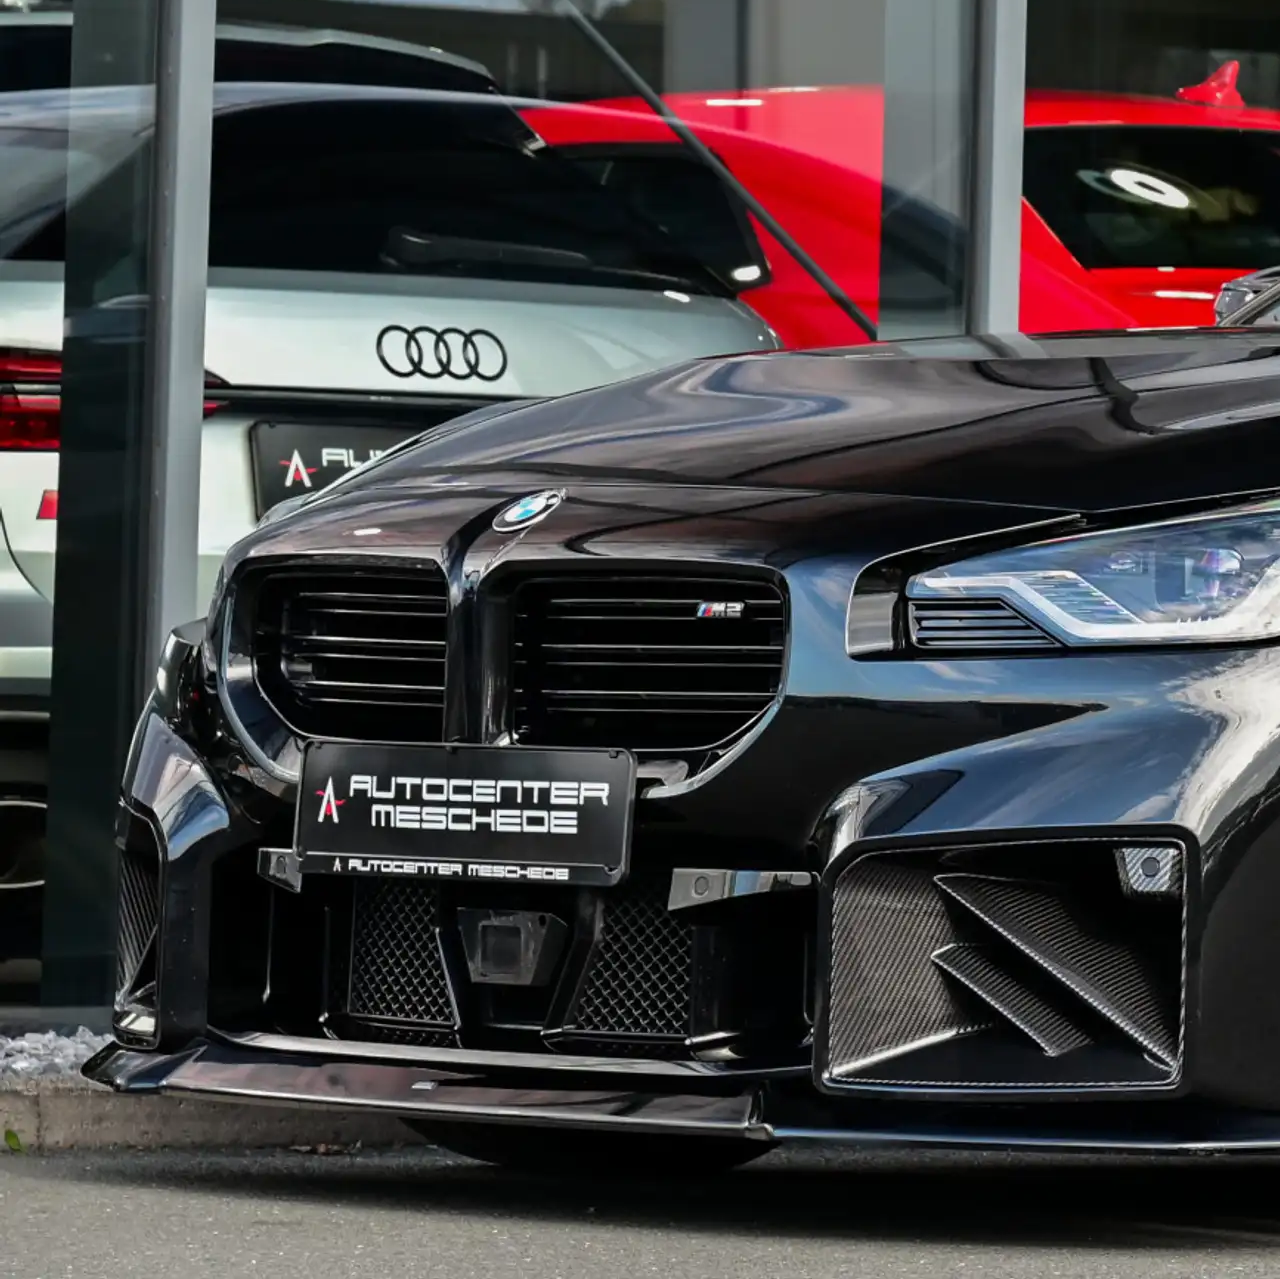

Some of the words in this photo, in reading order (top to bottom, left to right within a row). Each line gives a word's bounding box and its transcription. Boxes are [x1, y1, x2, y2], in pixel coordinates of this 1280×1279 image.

[349, 774, 610, 807] AUTOCENTER
[371, 803, 579, 835] MESCHEDE
[348, 858, 463, 876] AUTOCENTER
[467, 863, 570, 881] MESCHEDE
